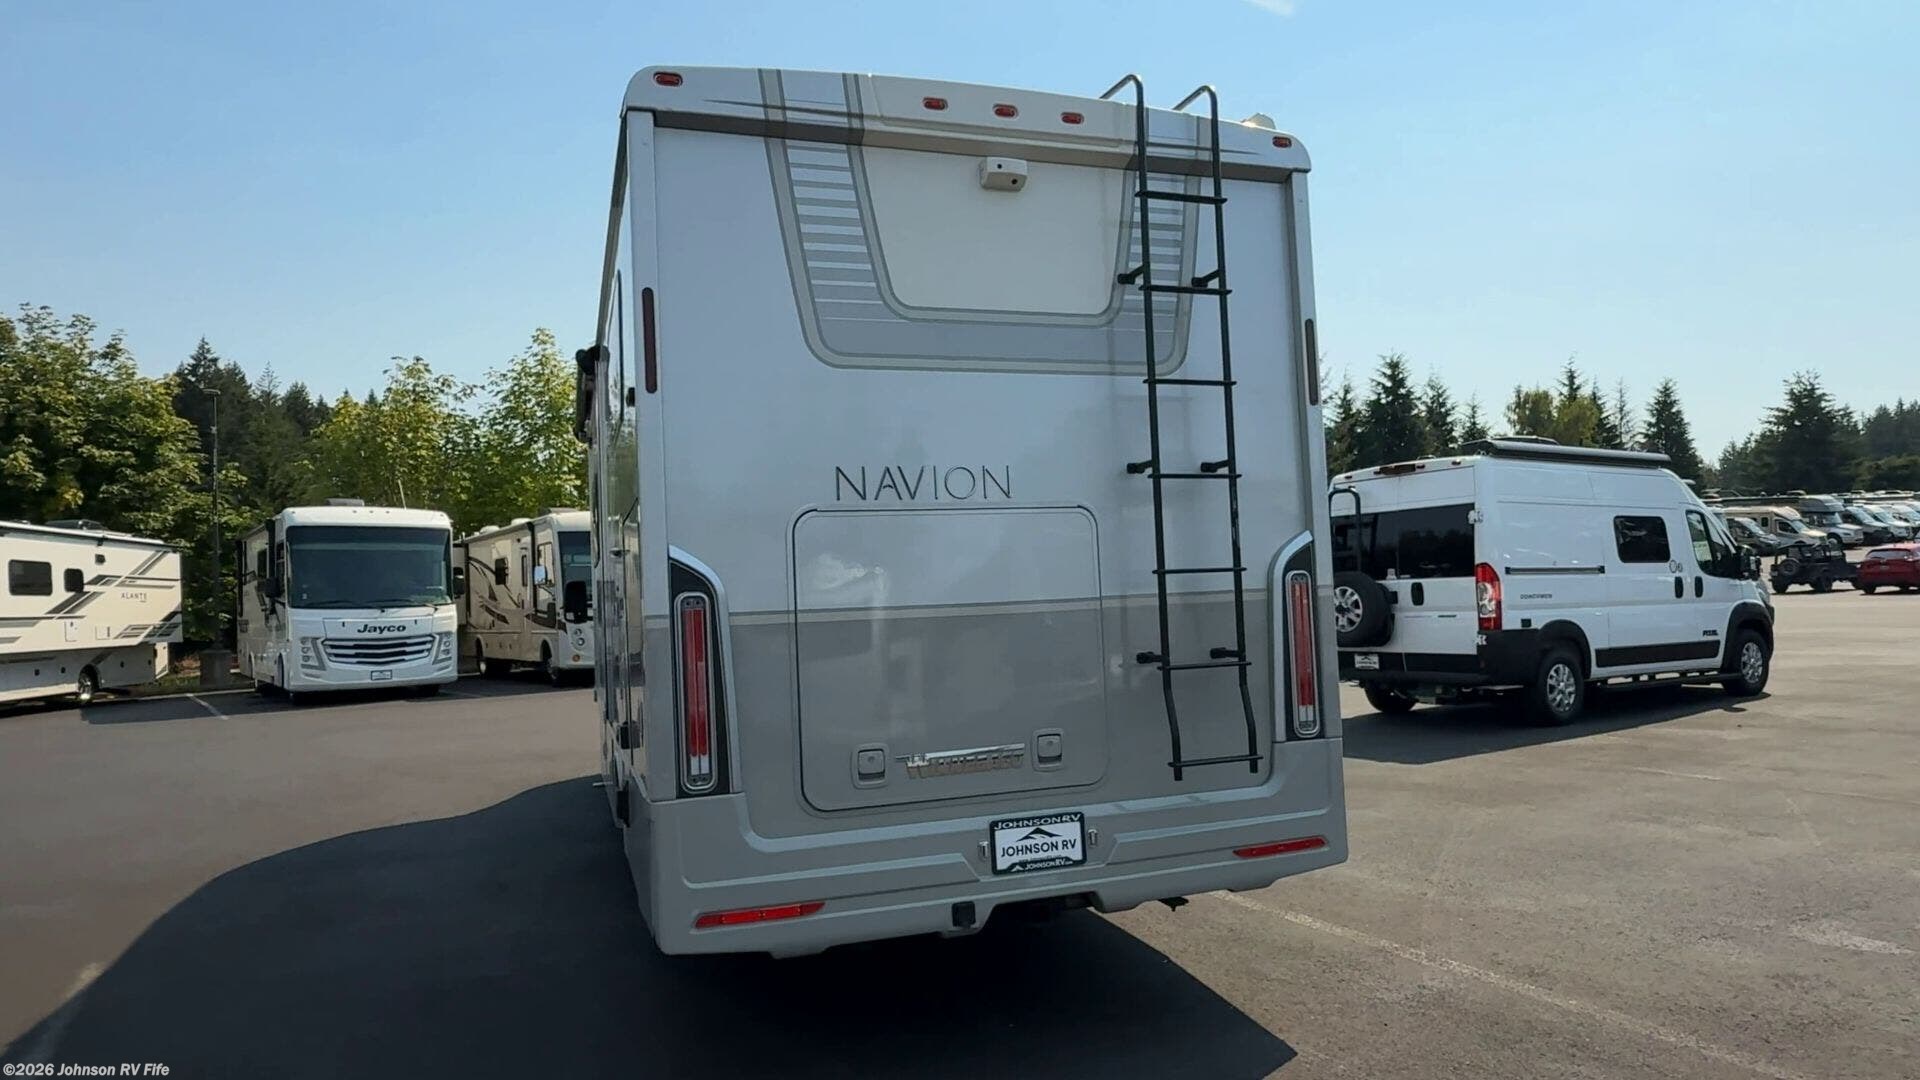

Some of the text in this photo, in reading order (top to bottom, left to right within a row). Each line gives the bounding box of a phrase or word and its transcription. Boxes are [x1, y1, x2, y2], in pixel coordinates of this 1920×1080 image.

[836, 465, 1011, 501] NAVION
[357, 624, 406, 634] Jayco
[1001, 839, 1077, 857] JOHNSON RV
